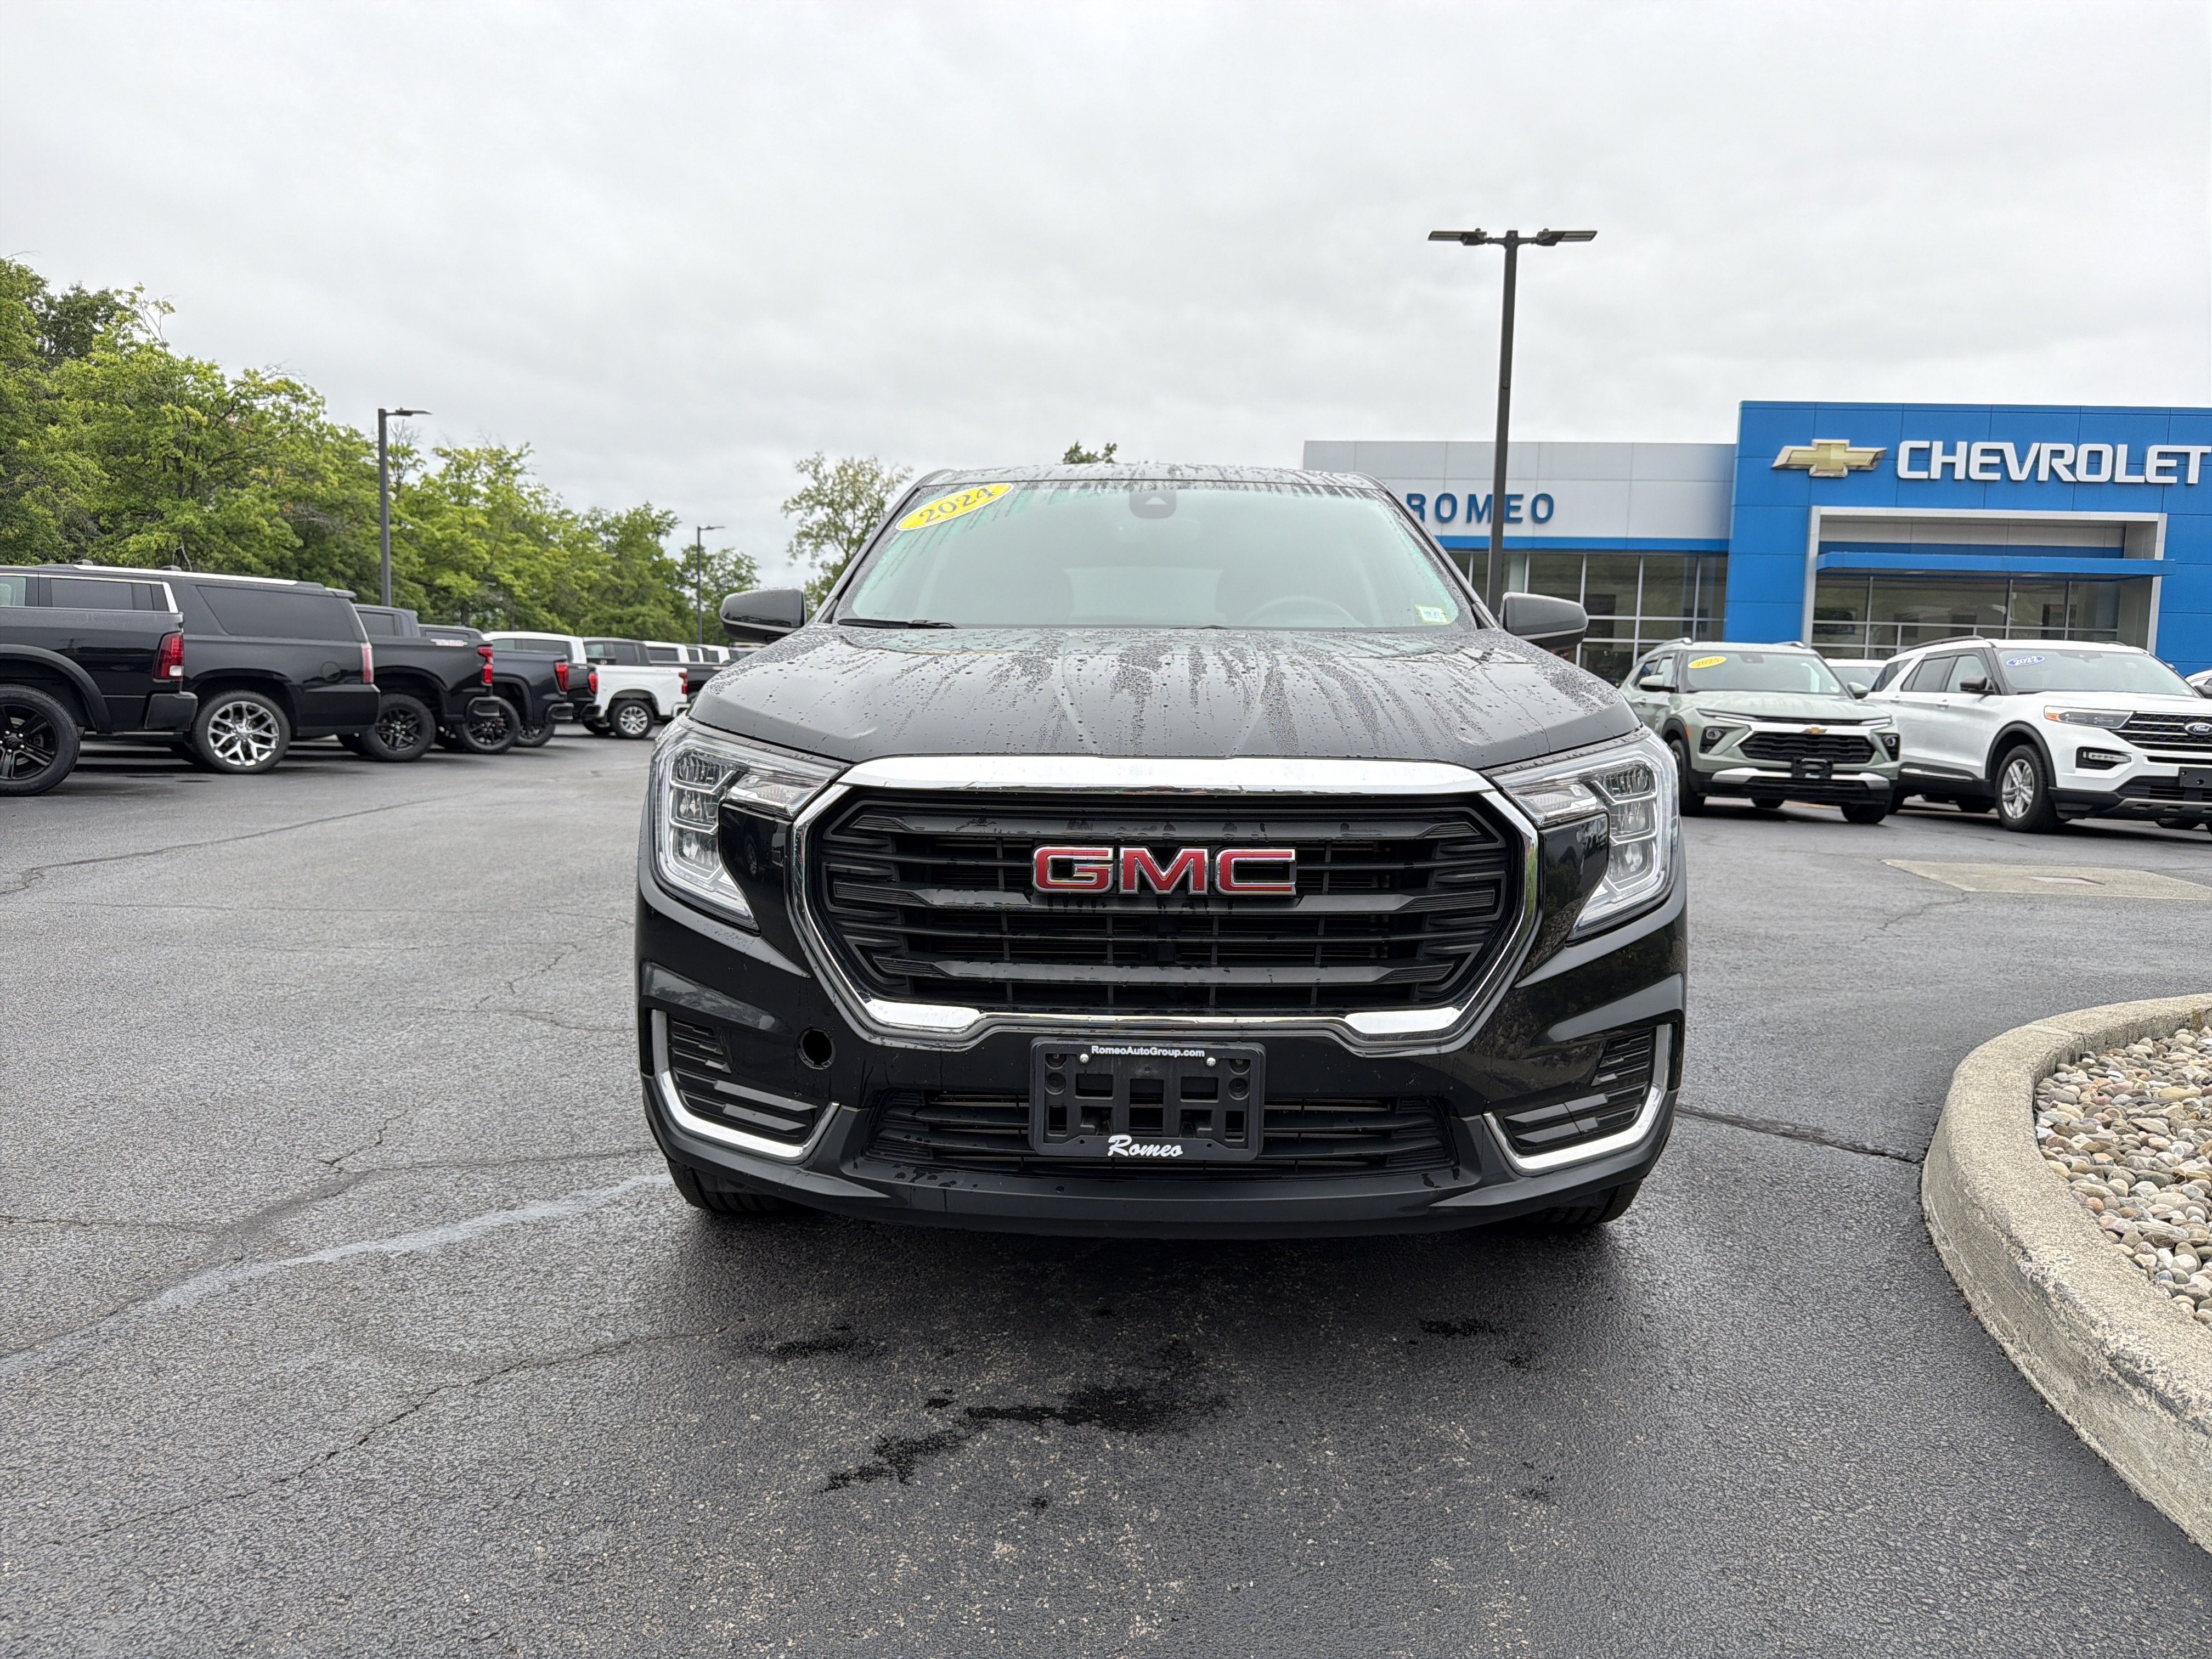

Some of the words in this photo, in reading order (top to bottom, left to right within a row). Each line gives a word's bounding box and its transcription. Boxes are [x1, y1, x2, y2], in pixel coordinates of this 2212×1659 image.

[1897, 441, 2212, 484] CHEVROLET
[919, 488, 995, 523] 2024
[1406, 493, 1554, 523] ROMEO
[2013, 656, 2039, 666] 2022
[1032, 845, 1297, 896] GMC
[1091, 1045, 1205, 1058] RomeoAutoGroup.com
[1107, 1134, 1183, 1157] Romeo
